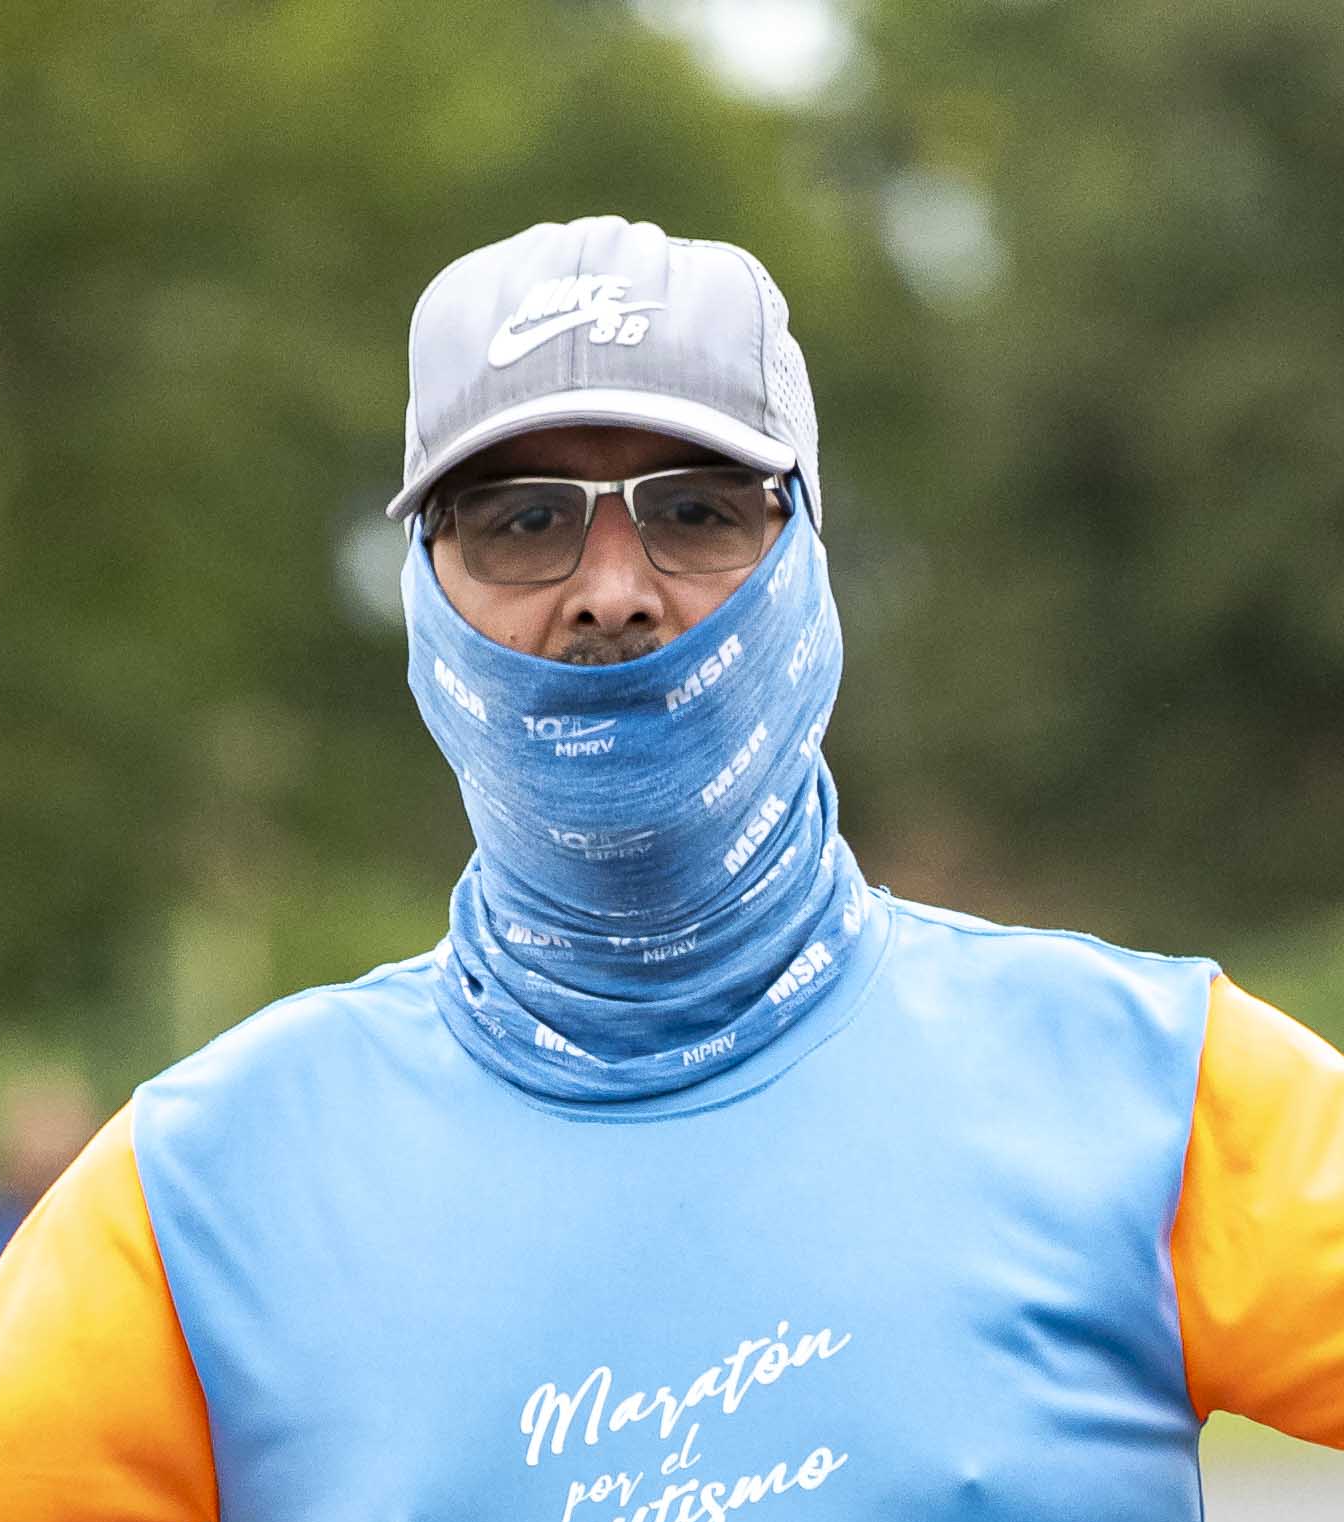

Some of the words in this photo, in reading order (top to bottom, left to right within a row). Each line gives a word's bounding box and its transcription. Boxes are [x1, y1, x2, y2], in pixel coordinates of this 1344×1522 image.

[434, 655, 488, 723] MSR
[665, 634, 744, 713] MSR
[555, 736, 616, 758] MPRV
[722, 792, 788, 878] MSR
[766, 941, 833, 1005] MSR
[682, 1032, 737, 1067] MPRV
[520, 1320, 851, 1467] Maratón
[660, 1423, 702, 1476] el
